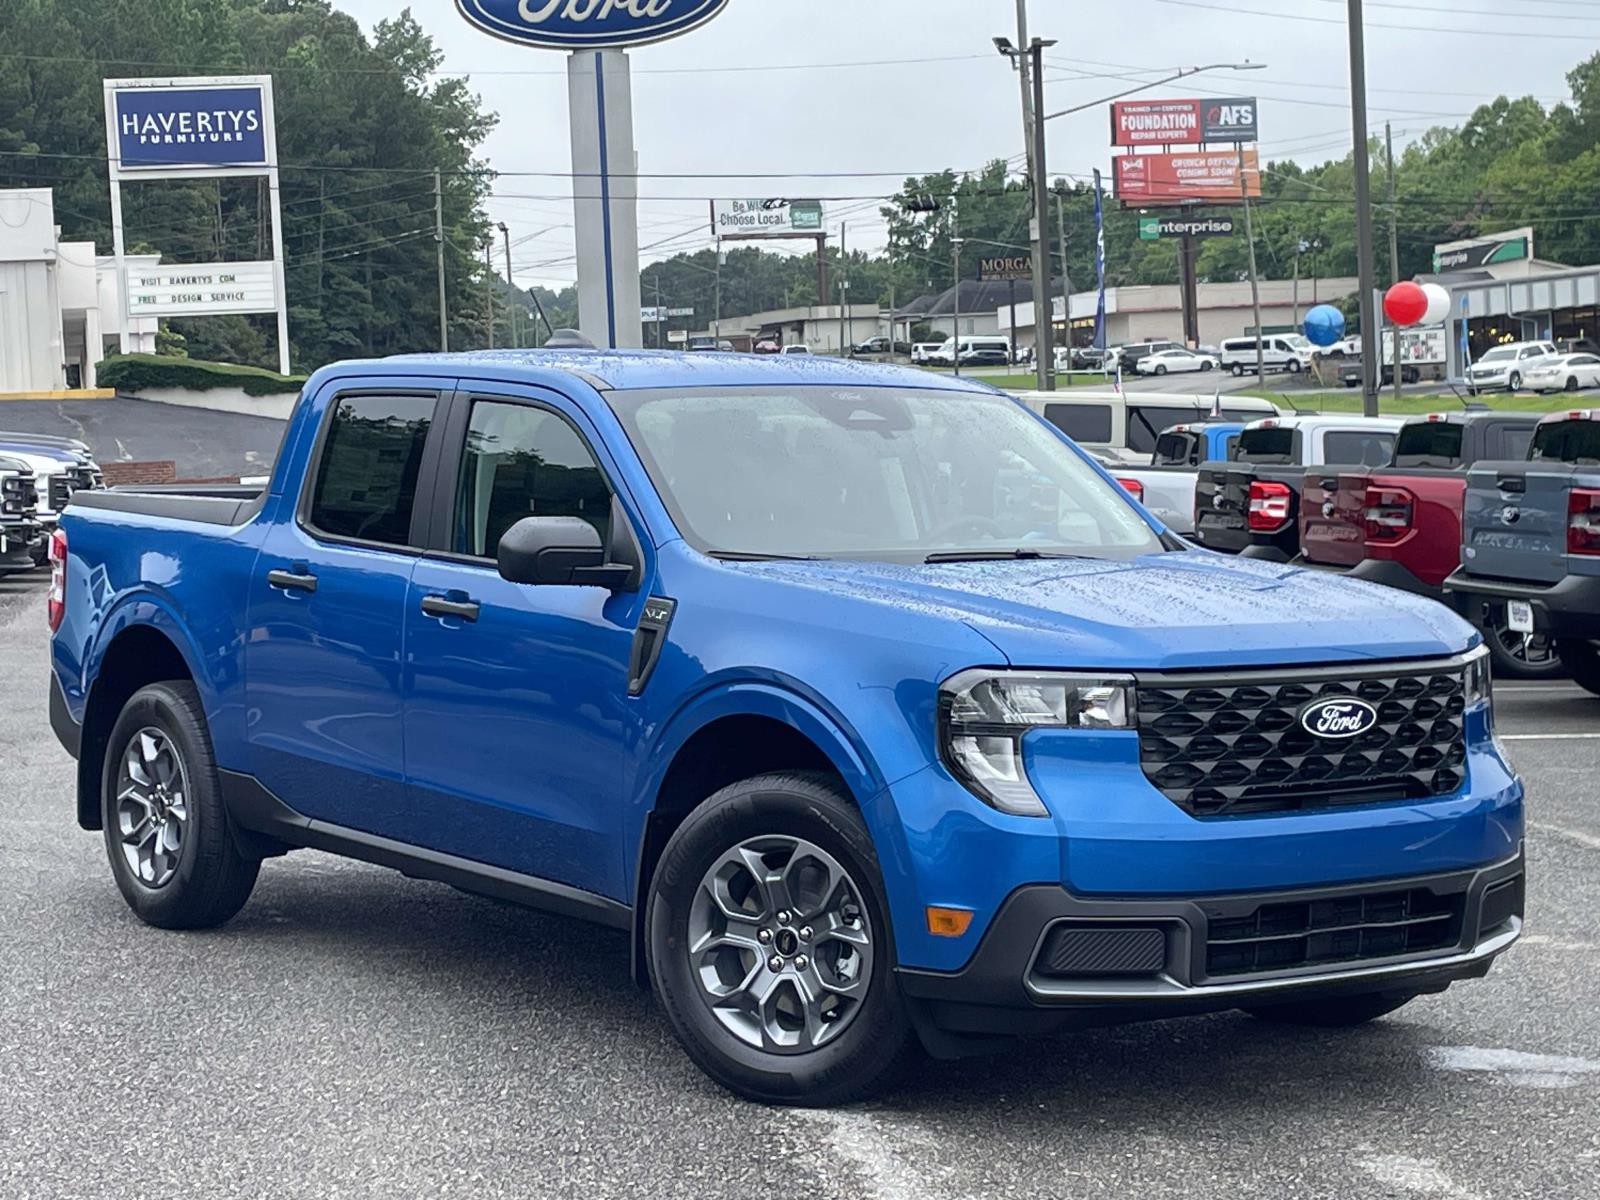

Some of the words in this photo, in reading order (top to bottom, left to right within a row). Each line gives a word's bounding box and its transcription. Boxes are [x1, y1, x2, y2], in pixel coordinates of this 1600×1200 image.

[122, 109, 259, 135] HAVERTYS
[1120, 113, 1197, 131] FOUNDATION
[1219, 105, 1253, 125] AFS
[140, 131, 243, 144] FURNITURE
[720, 213, 755, 226] Choose
[1143, 219, 1232, 235] enterprise
[981, 257, 1033, 271] MORGA
[140, 277, 161, 286] VISIT
[169, 275, 213, 285] HAVERTYS
[219, 274, 236, 283] COM
[138, 295, 157, 305] FREE
[171, 293, 203, 303] DESIGN
[210, 291, 245, 301] SERVICE
[1317, 705, 1363, 732] Ford
